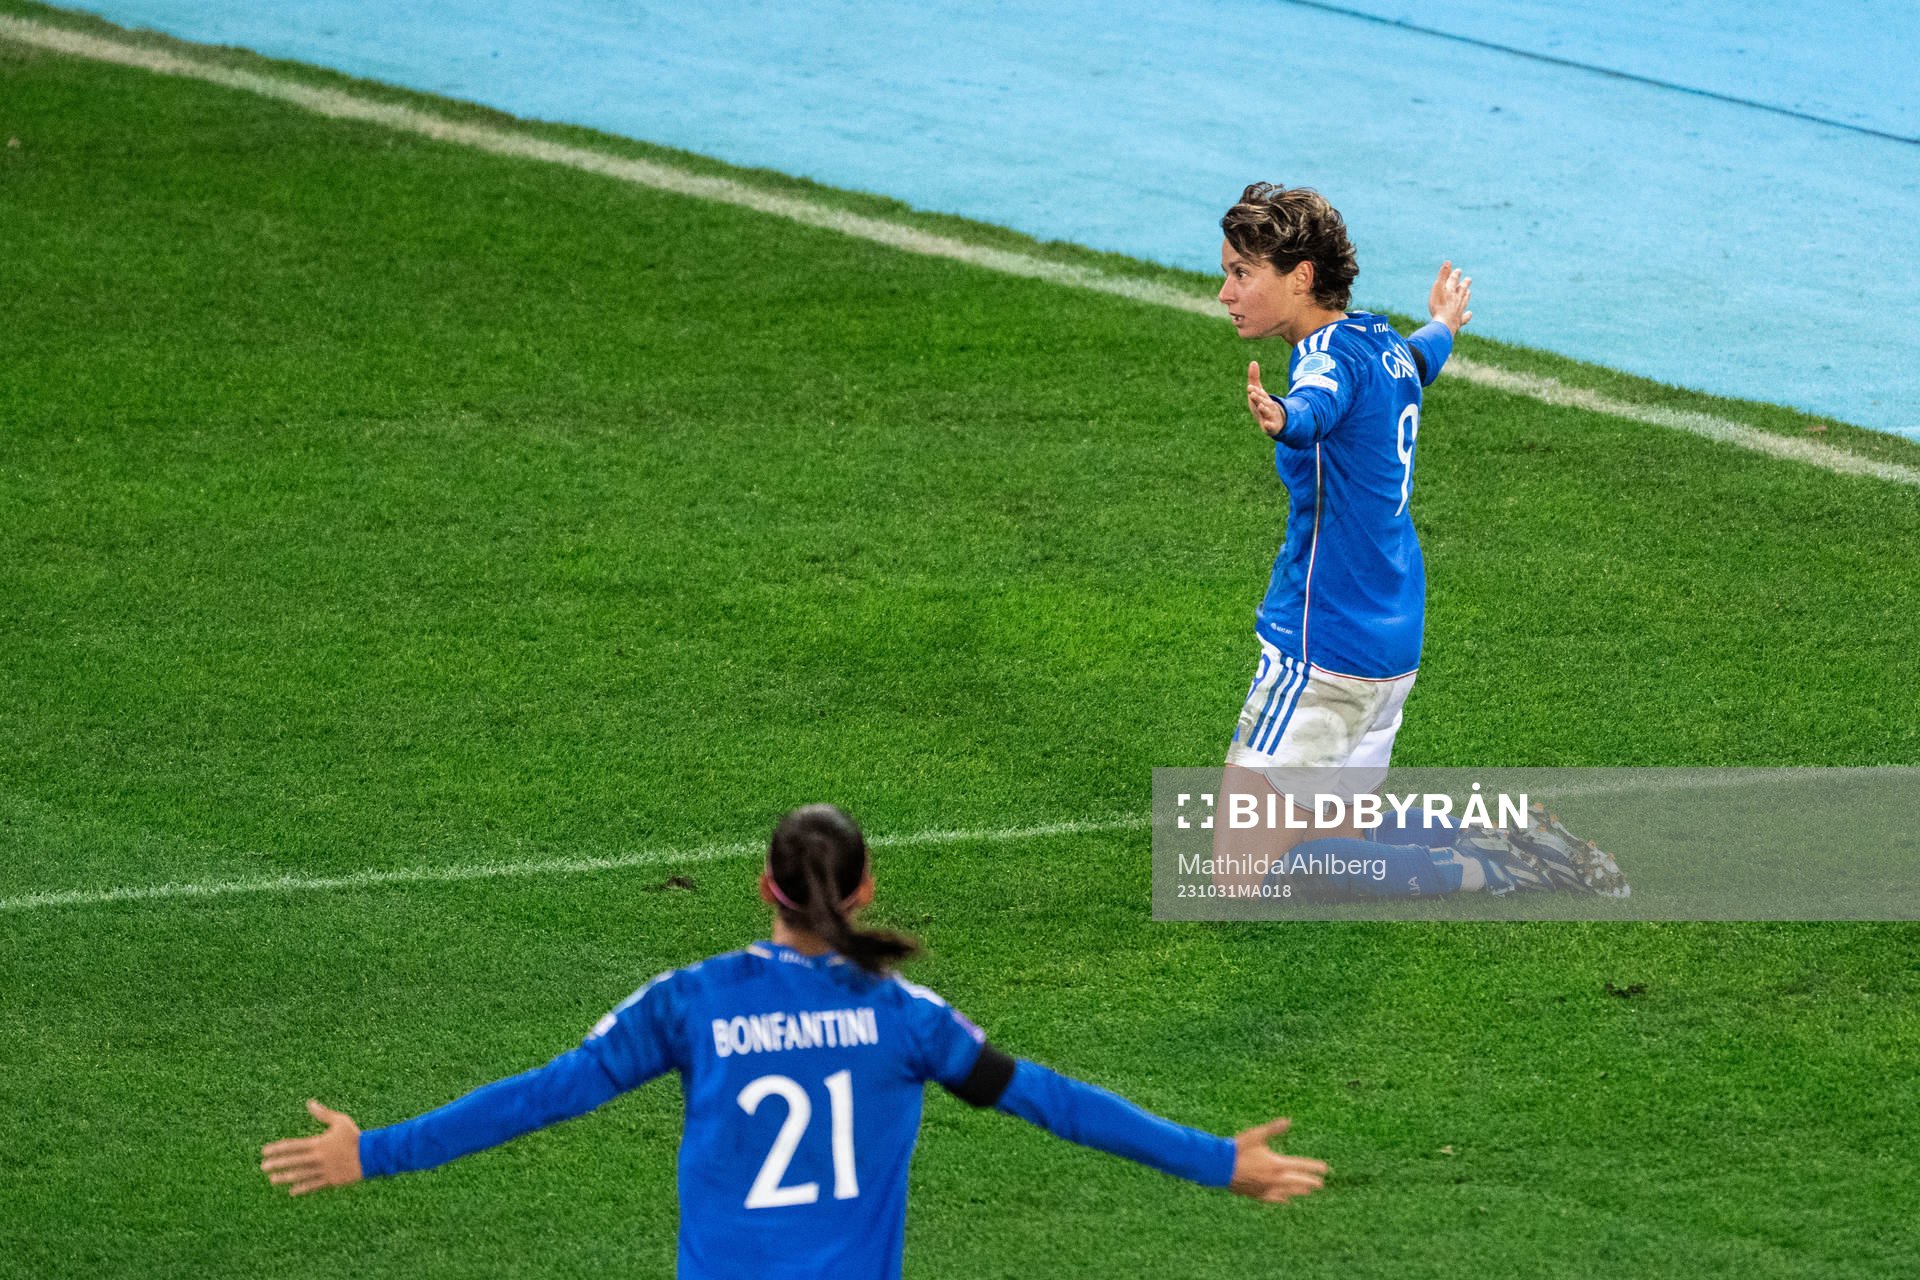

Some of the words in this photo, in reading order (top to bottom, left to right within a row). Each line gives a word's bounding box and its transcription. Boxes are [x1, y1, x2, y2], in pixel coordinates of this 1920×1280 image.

[1394, 403, 1419, 518] 9
[711, 1007, 879, 1058] BONFANTINI
[736, 1069, 860, 1210] 21
